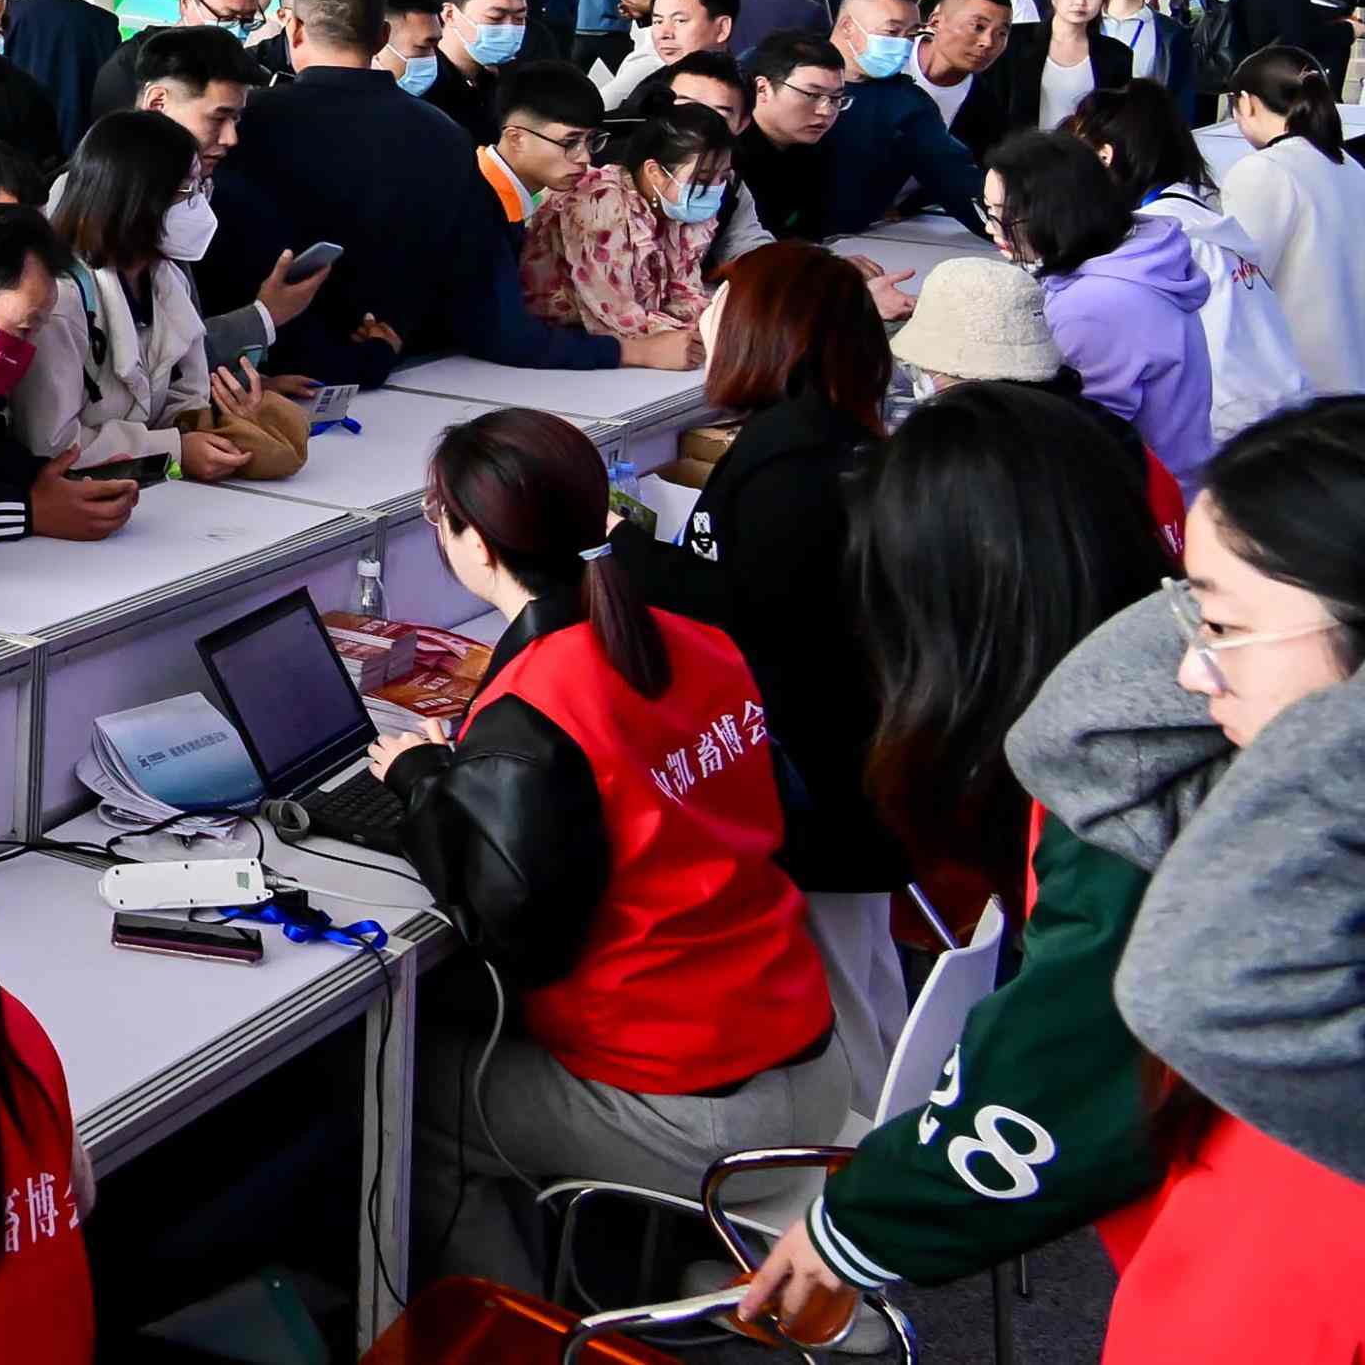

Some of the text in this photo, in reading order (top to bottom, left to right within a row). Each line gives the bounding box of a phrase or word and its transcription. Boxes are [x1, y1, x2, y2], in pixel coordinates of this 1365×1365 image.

[650, 700, 768, 806] 中凯畜博会
